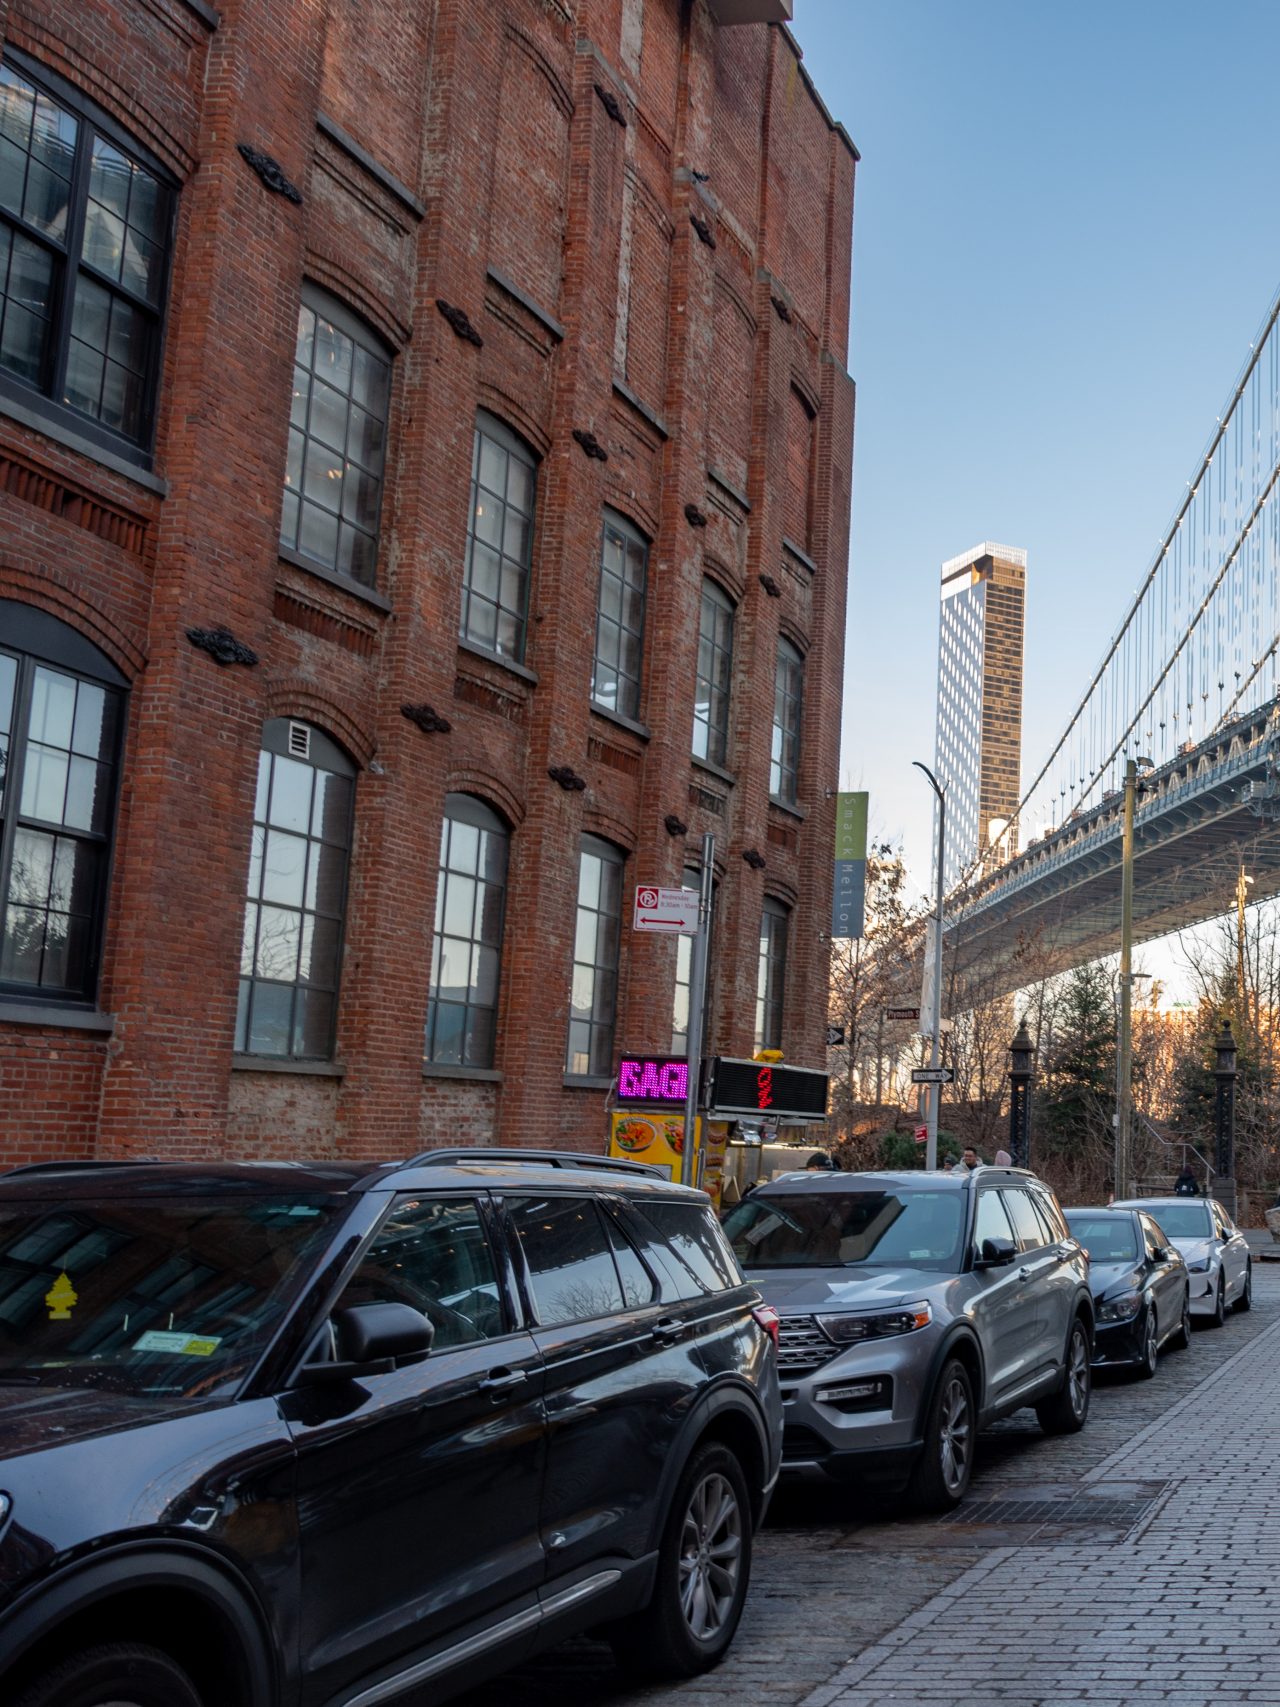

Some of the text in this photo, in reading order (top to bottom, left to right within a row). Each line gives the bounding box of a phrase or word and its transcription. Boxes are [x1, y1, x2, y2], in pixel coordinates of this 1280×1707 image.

[840, 798, 856, 934] Smack Mellon
[916, 1072, 948, 1080] ONE WAY
